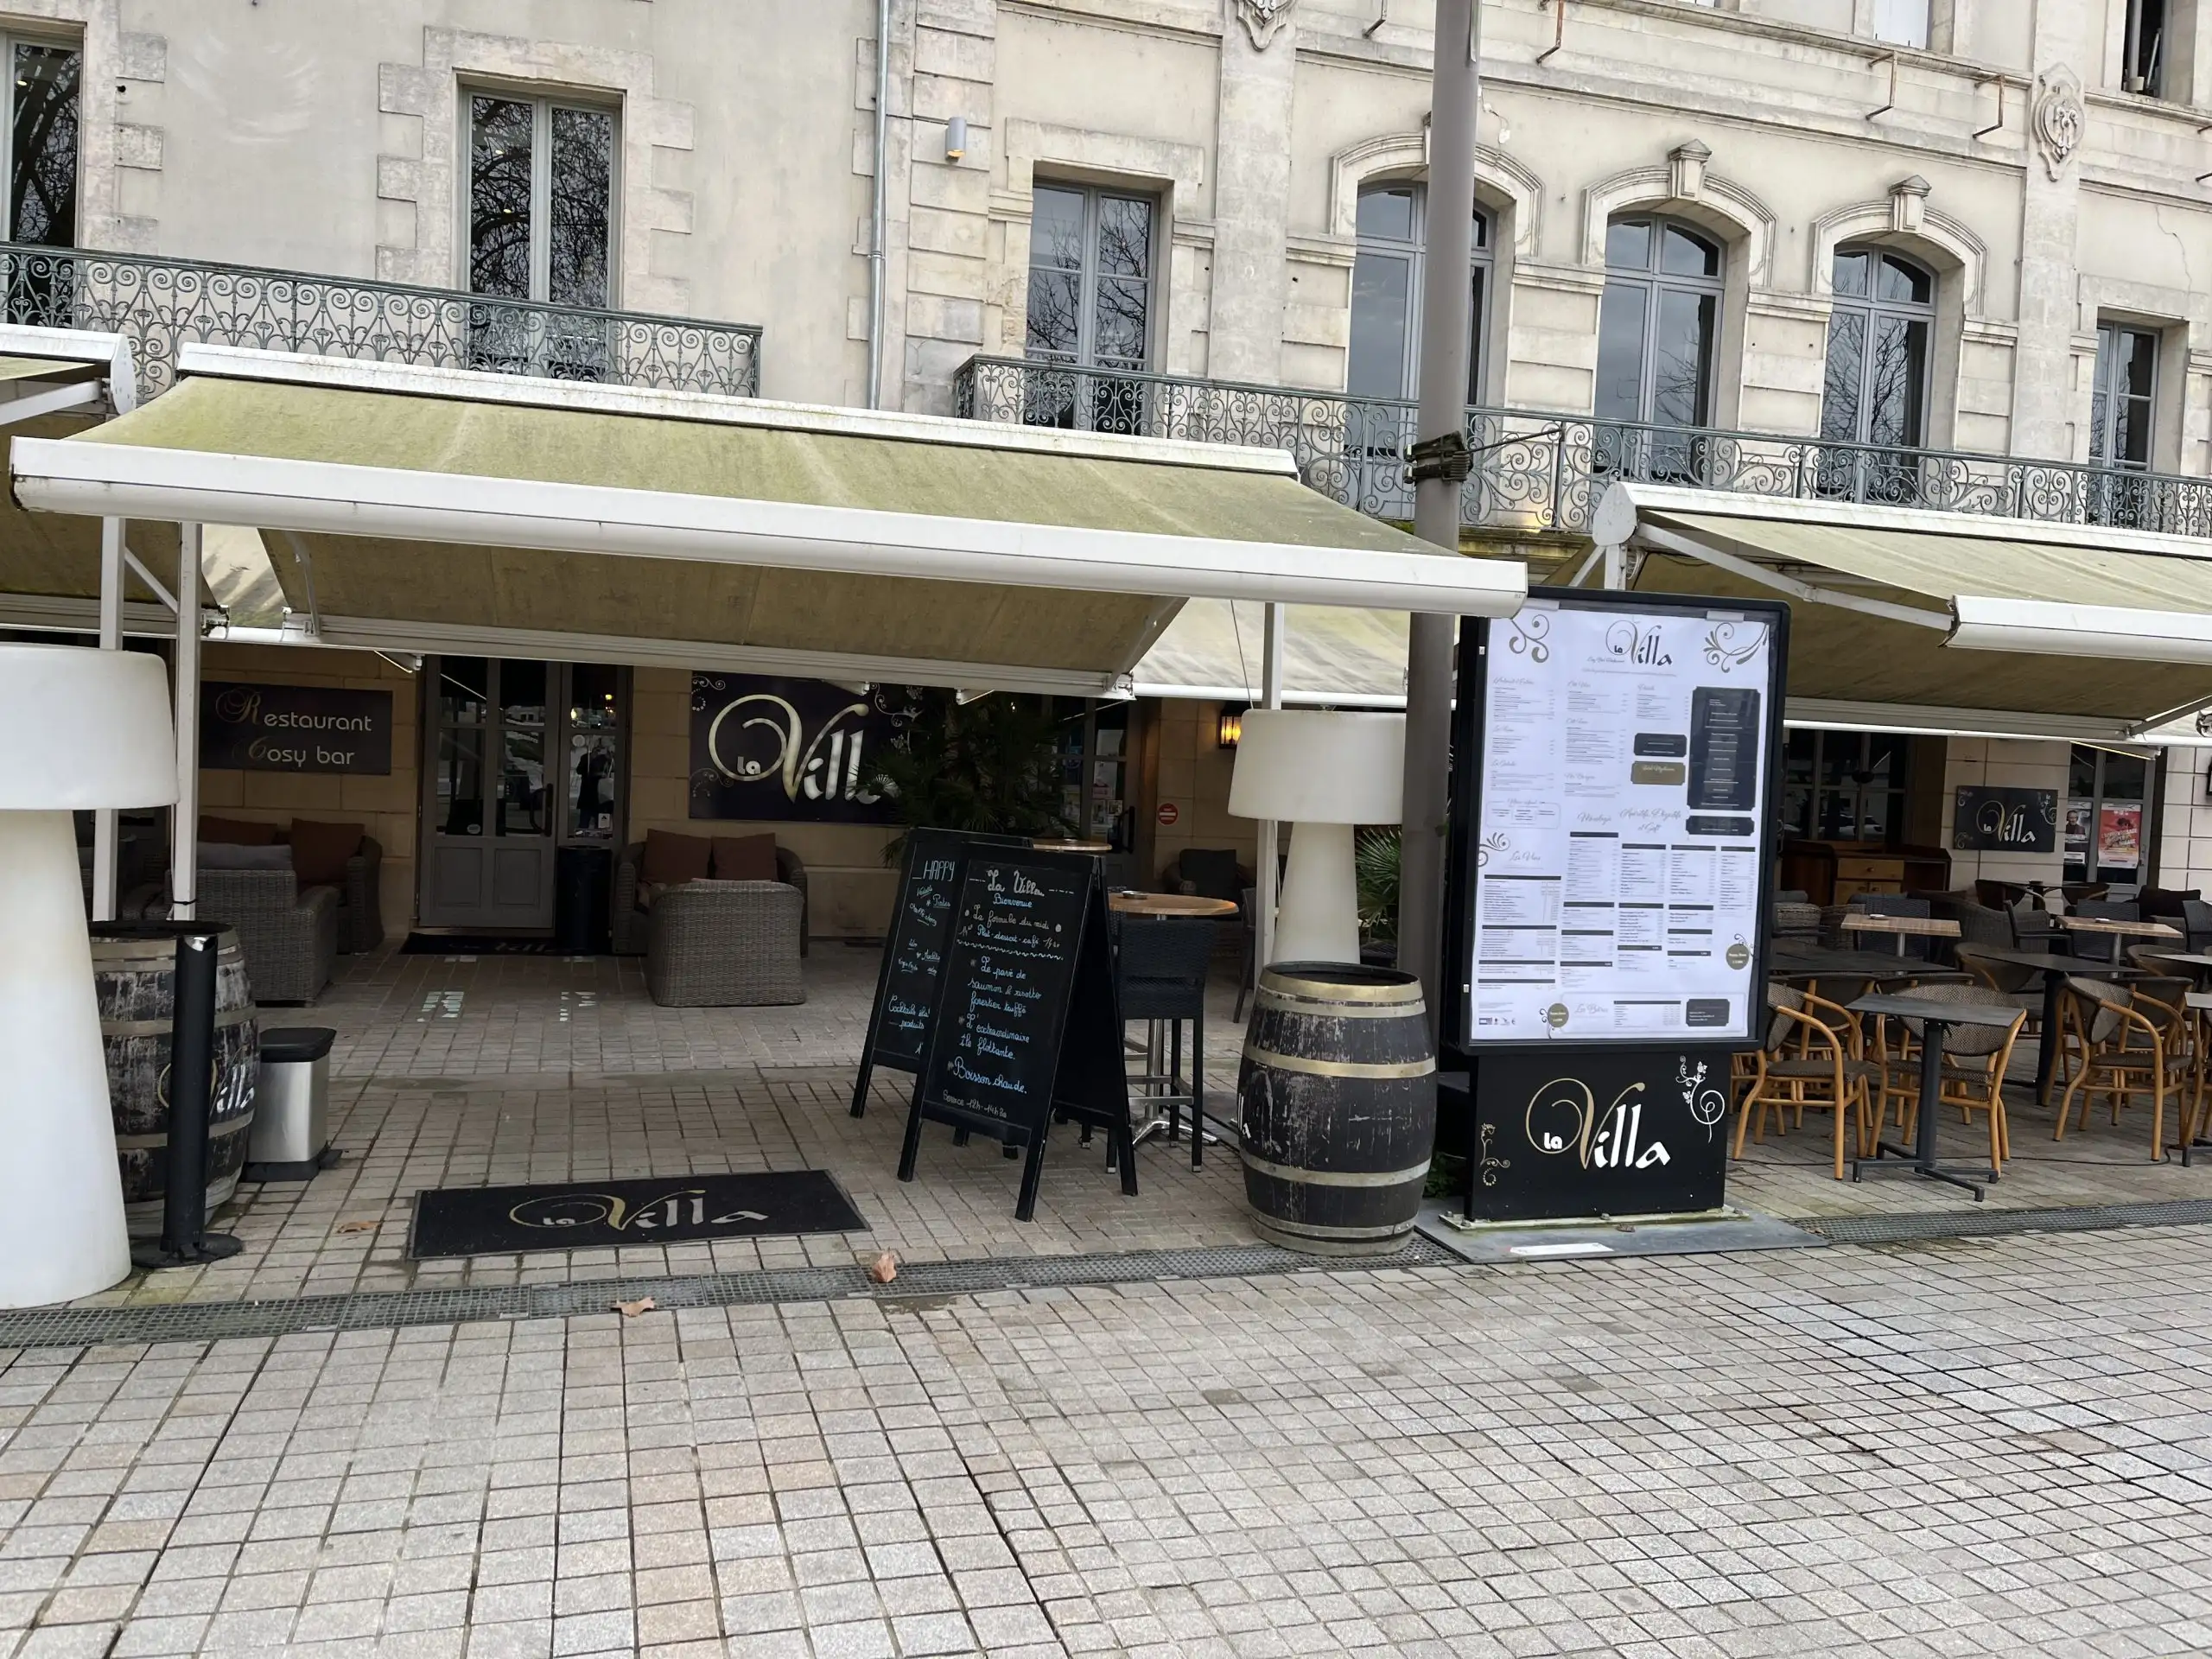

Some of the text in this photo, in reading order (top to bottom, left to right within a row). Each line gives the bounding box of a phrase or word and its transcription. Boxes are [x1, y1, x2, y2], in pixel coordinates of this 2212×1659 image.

[1605, 620, 1673, 666] Villa
[216, 686, 372, 732] Restaurant
[232, 735, 356, 768] Cosy bar
[736, 755, 762, 776] la
[1976, 800, 2036, 843] Villa
[923, 860, 956, 881] HAPPY
[987, 869, 1045, 897] La Villa
[993, 893, 1033, 908] Bienvenue
[973, 904, 984, 921] La
[987, 910, 1016, 929] formule
[1019, 917, 1032, 927] du
[981, 956, 1026, 979] Le pavé de
[969, 990, 1001, 1013] forestier
[953, 1056, 991, 1085] Boisson
[1526, 1077, 1671, 1170] la Villa
[509, 1189, 770, 1231] Villa
